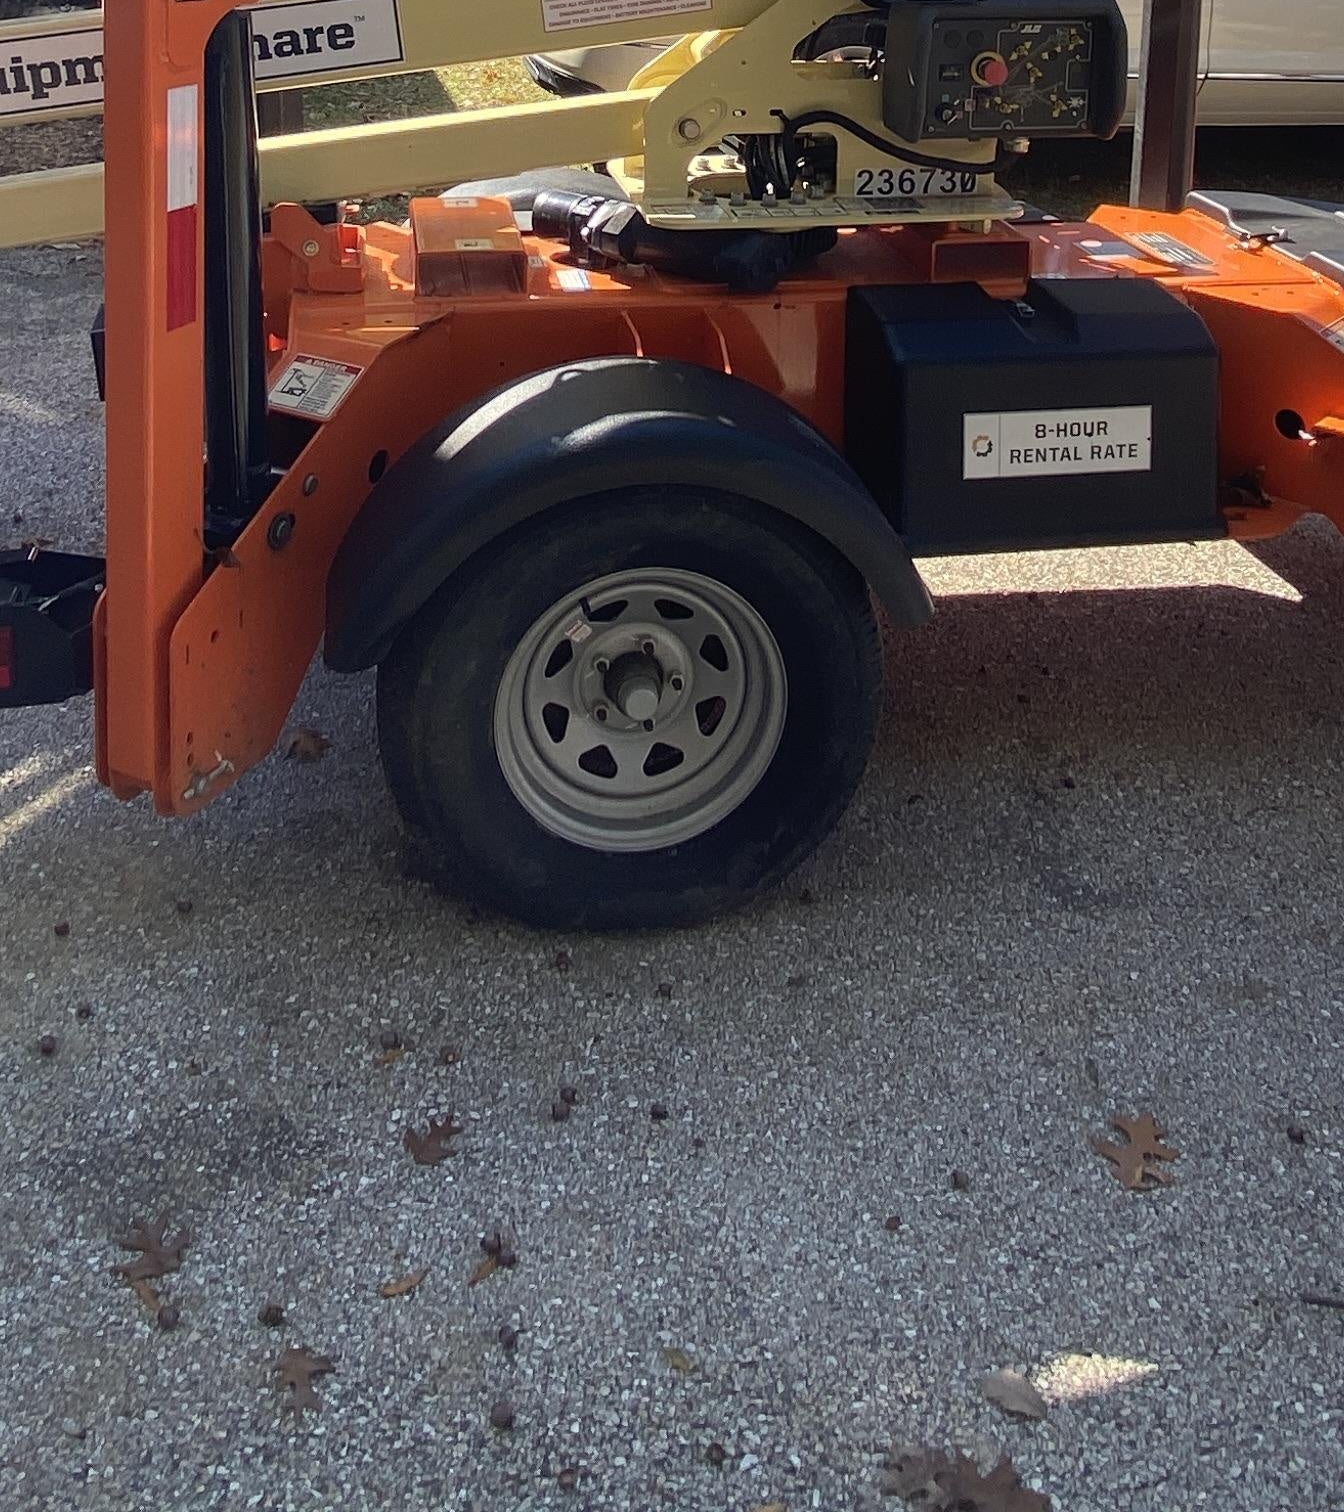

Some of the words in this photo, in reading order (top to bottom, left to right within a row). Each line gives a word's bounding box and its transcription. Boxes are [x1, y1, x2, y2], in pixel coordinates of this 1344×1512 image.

[1034, 421, 1108, 438] 8-HOUR
[1010, 447, 1082, 464] RENTAL
[1090, 444, 1138, 460] RATE
